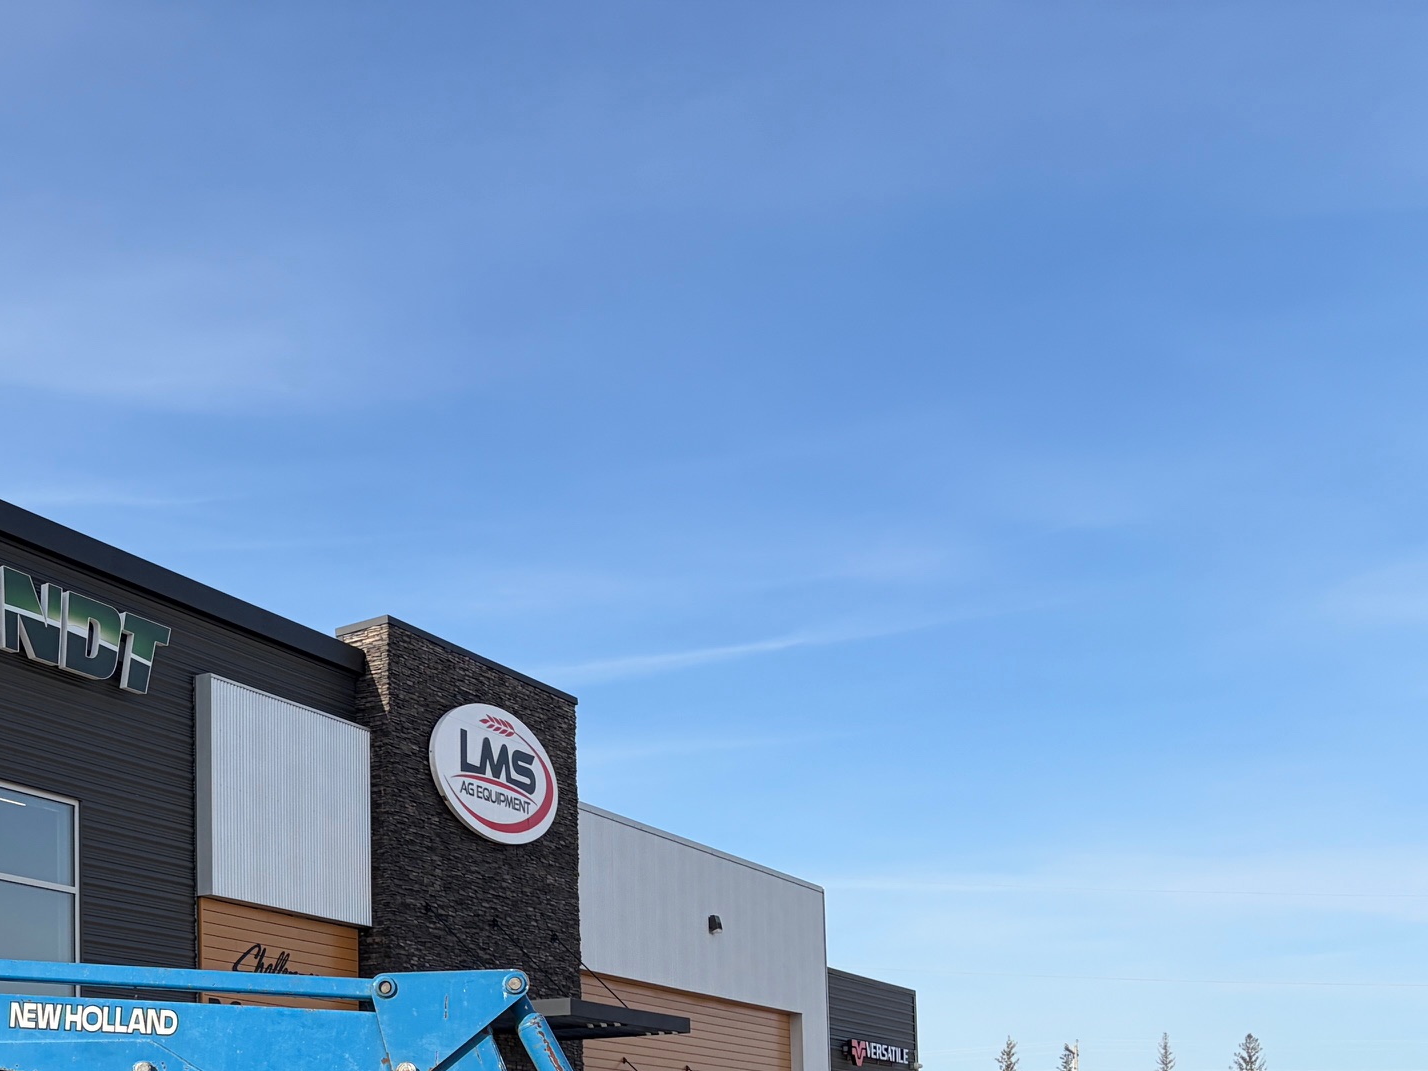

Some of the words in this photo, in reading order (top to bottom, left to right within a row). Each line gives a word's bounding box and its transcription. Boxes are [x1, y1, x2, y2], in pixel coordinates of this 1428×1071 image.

[460, 728, 536, 795] LMS
[460, 780, 474, 797] AG
[477, 785, 531, 814] EQUIPMENT
[9, 1001, 63, 1030] NEW
[64, 1004, 179, 1036] HOLLAND
[865, 1041, 909, 1064] VERSATILE
